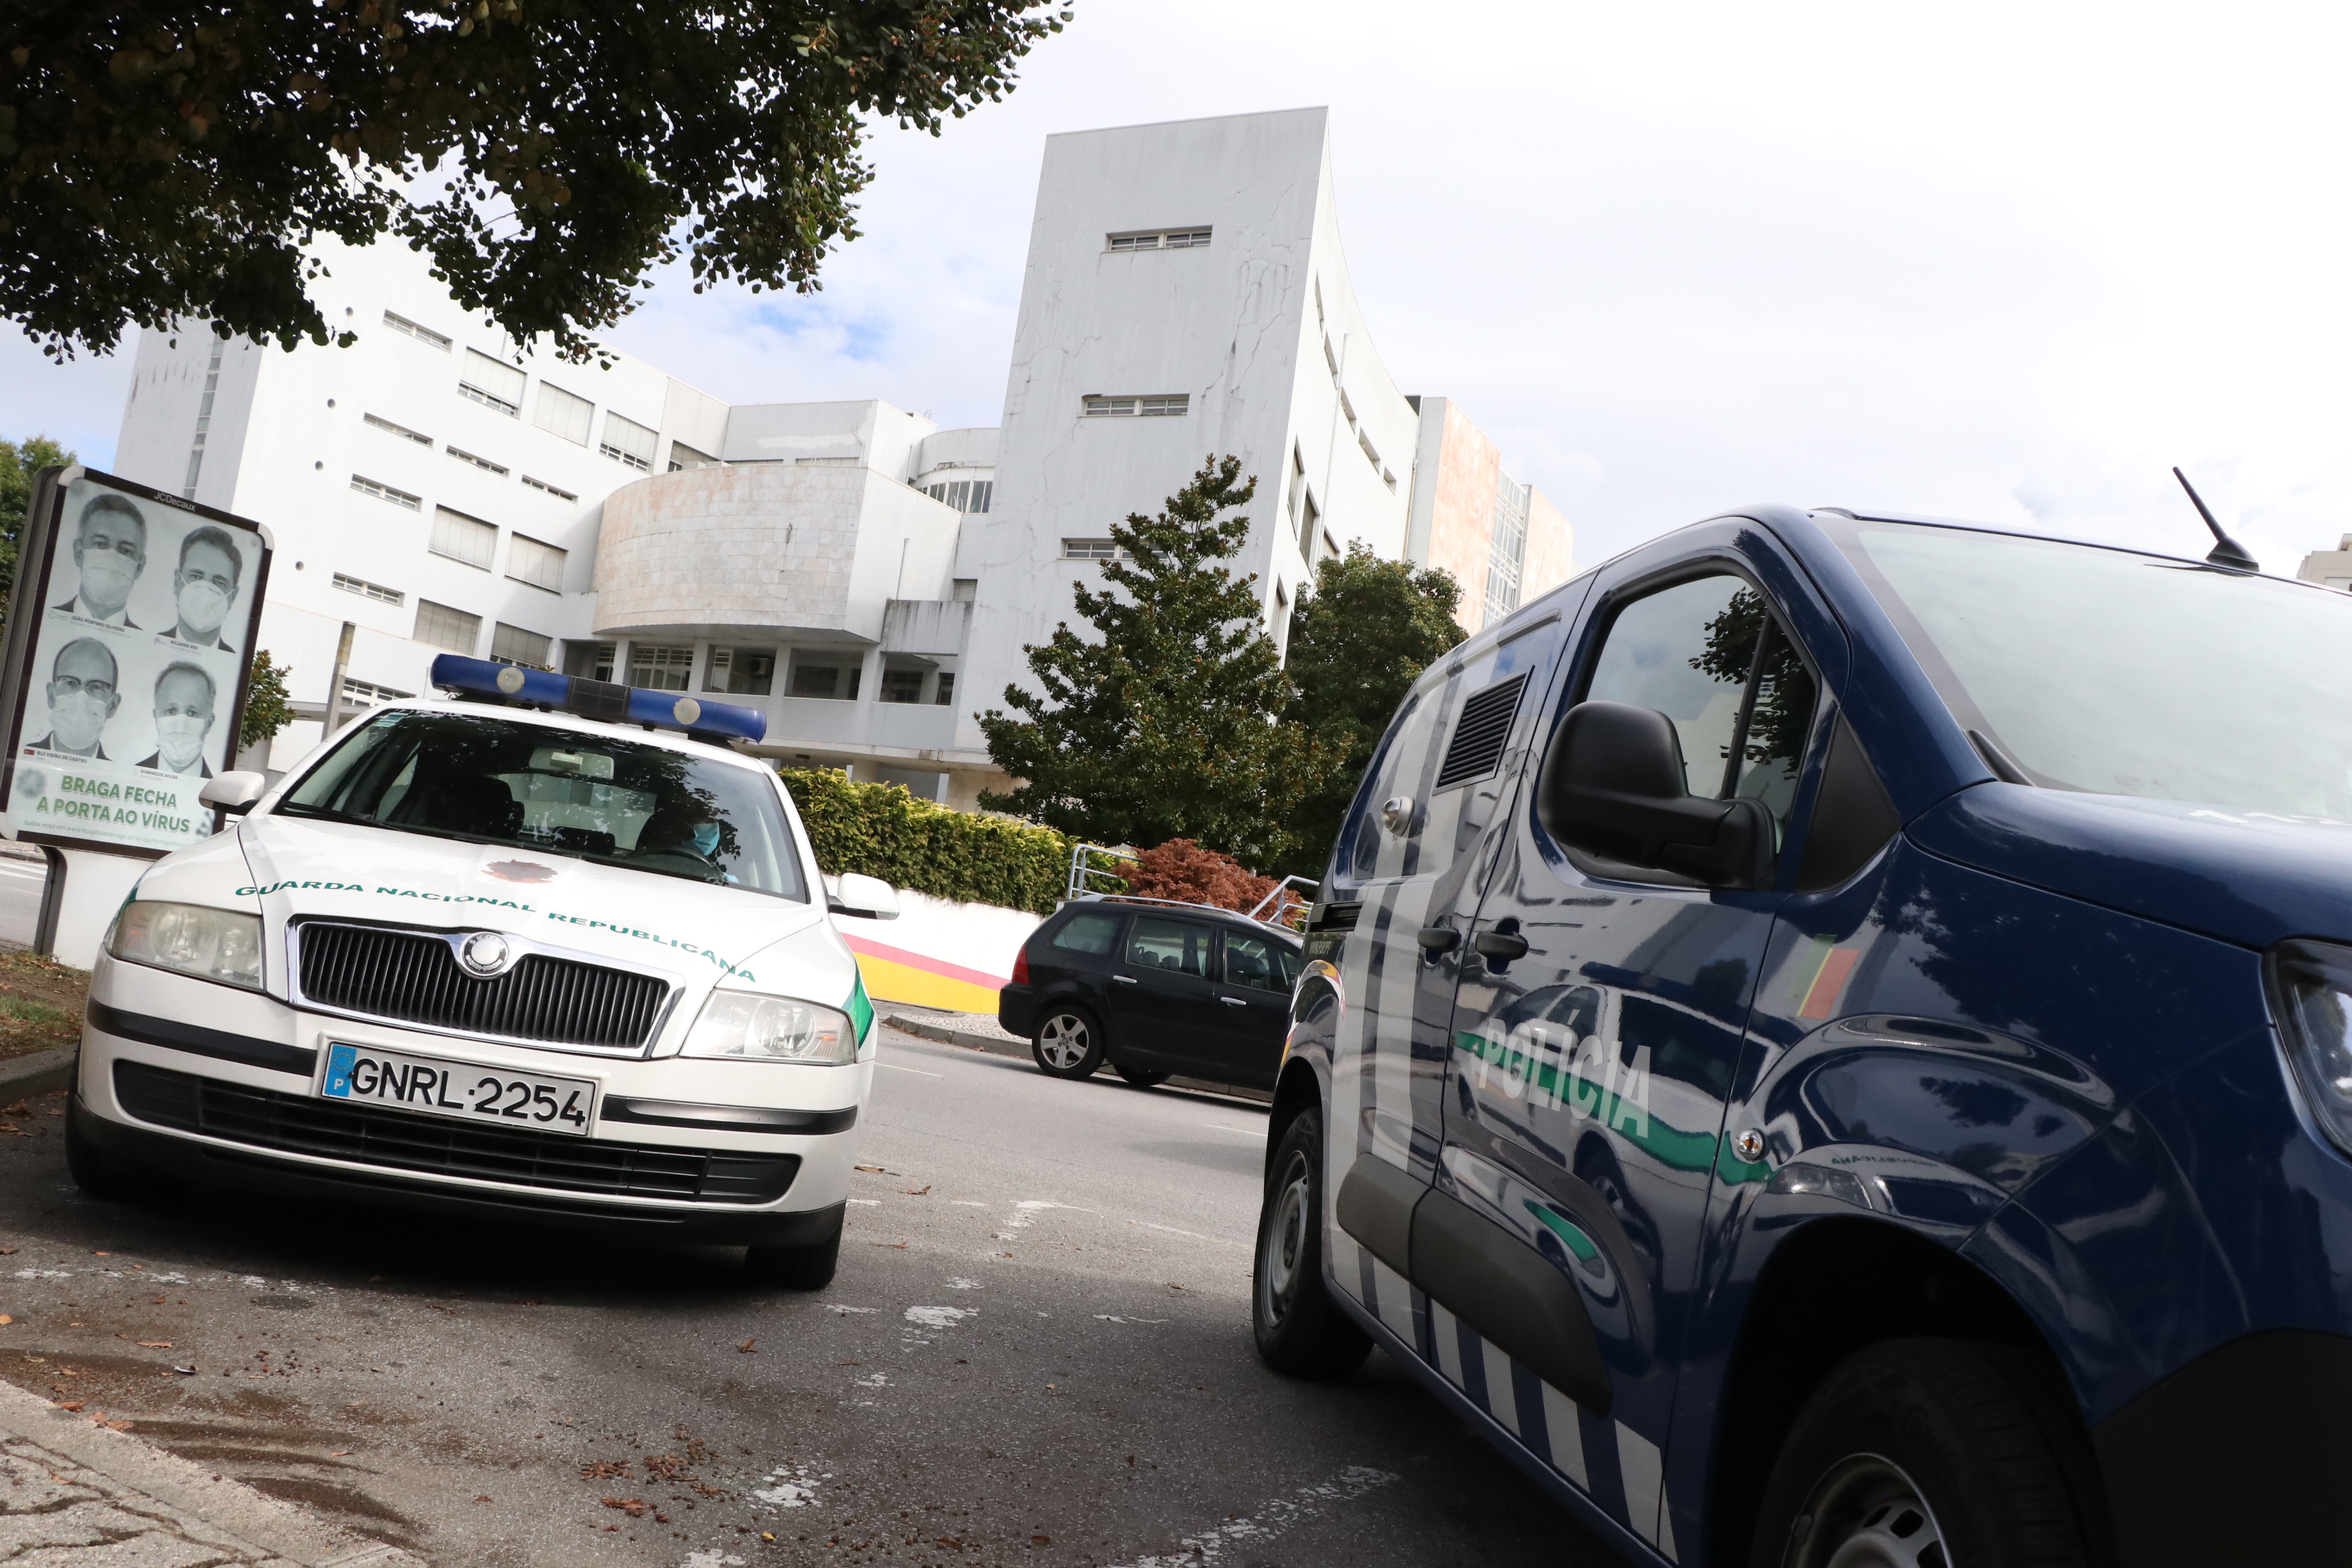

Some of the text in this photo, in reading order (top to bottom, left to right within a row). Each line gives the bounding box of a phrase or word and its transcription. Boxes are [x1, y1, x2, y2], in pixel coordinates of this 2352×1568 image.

[154, 491, 196, 512] JCDecaux
[105, 623, 125, 632] OLIVEIRA
[170, 640, 190, 648] RICARDO
[141, 769, 164, 778] DOMINGOS
[61, 775, 177, 808] BRAGA FECHA
[36, 796, 190, 833] A PORTA AO VÍRUS
[235, 880, 757, 983] GUARDA NACIONAL REPUBLICANA
[333, 1077, 345, 1090] P
[1478, 1008, 1651, 1139] POLÍCIA
